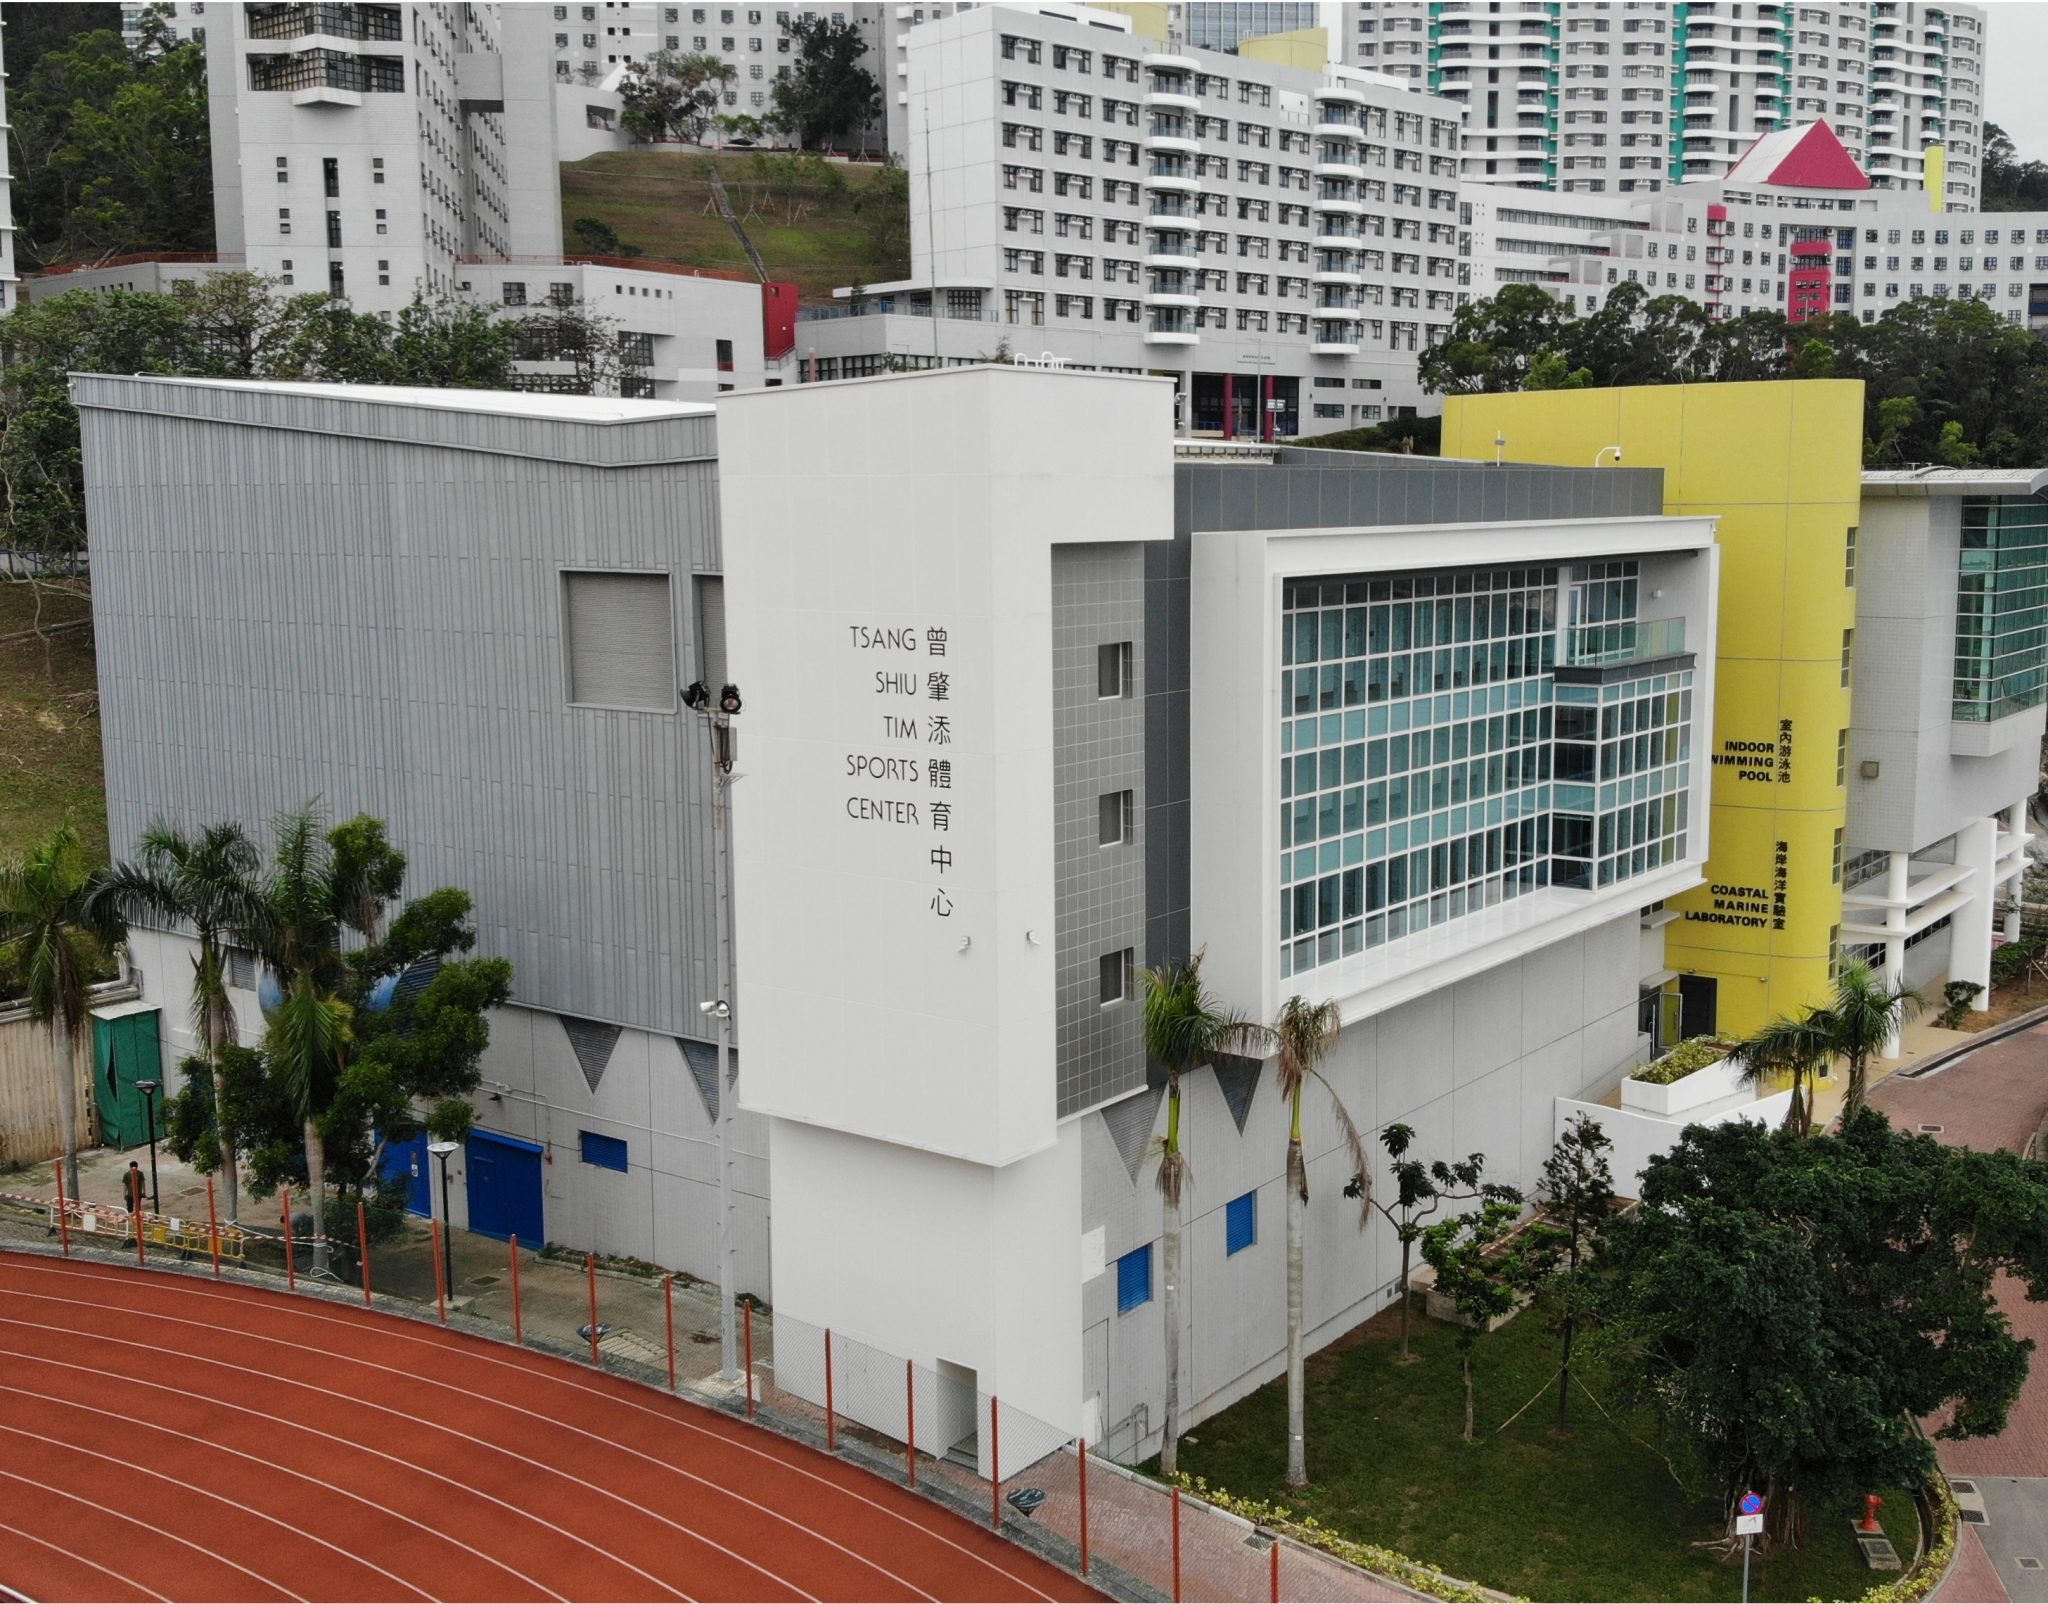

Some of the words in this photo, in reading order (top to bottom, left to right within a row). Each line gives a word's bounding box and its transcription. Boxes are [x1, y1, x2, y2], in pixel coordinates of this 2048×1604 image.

[849, 626, 917, 651] TSANG
[875, 671, 917, 695] SHIU
[883, 715, 918, 740] TIM
[1725, 740, 1775, 753] INDOOR
[846, 754, 919, 782] SPORTS
[926, 626, 954, 917] 曾肇添體育中心
[1711, 754, 1774, 768] WIMMING
[1739, 770, 1773, 782] POOL
[846, 797, 920, 825] CENTER
[1711, 884, 1769, 900] COASTAL
[1714, 899, 1769, 914] MARINE
[1685, 910, 1768, 928] LABORATORY
